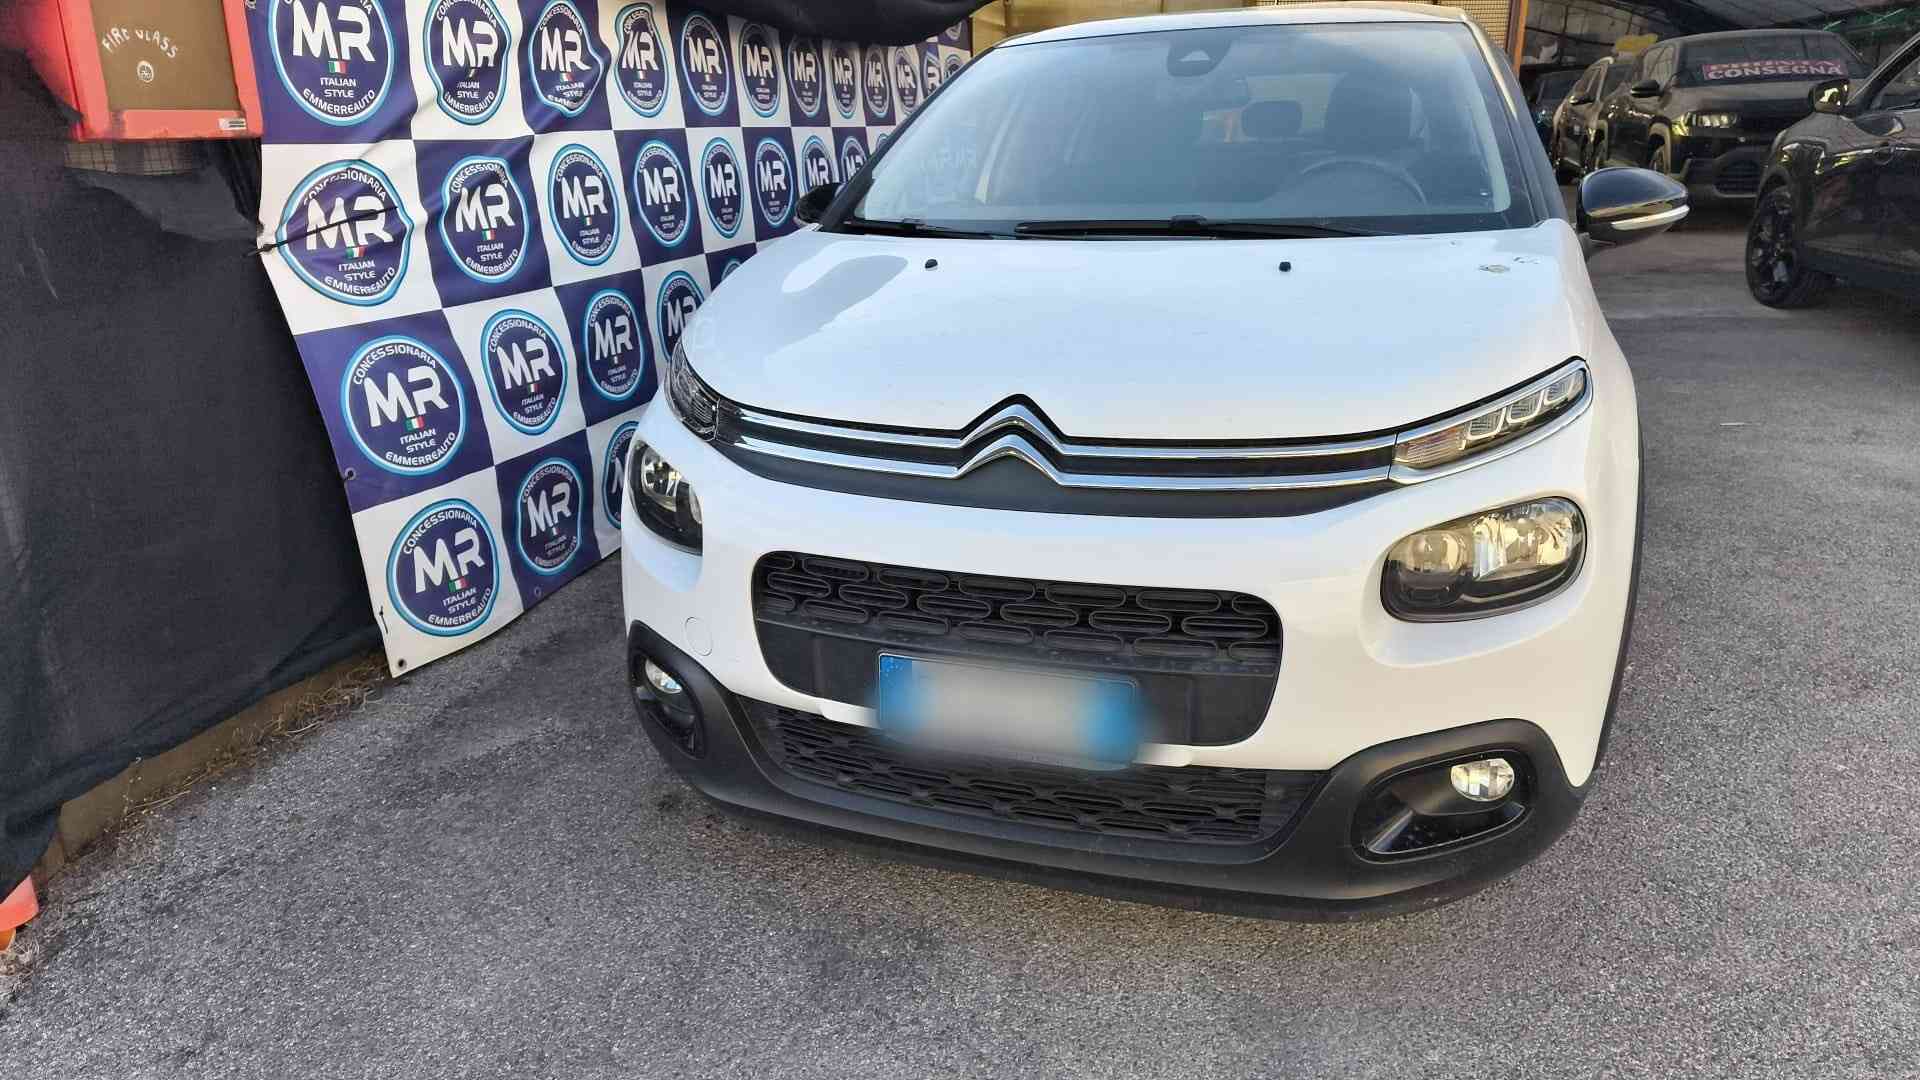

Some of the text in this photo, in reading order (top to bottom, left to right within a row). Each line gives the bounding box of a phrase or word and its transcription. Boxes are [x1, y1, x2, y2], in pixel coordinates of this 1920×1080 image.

[293, 1, 376, 62] MR
[442, 16, 499, 68] MR
[541, 27, 592, 73] MR
[622, 31, 659, 71] MR
[687, 37, 722, 74] MR
[746, 44, 775, 79] MR
[794, 49, 817, 82] MR
[320, 77, 357, 87] ITALIAN
[833, 55, 854, 87] MR
[867, 60, 884, 88] MR
[897, 63, 916, 89] MR
[1708, 65, 1843, 79] CONSEGNA
[303, 88, 375, 115] EMMERREAUTO
[324, 89, 354, 98] STYLE
[457, 91, 480, 99] STYLE
[642, 166, 681, 206] MR
[709, 160, 737, 199] MR
[759, 159, 786, 192] MR
[806, 157, 830, 187] MR
[455, 184, 516, 232] MR
[561, 175, 608, 219] MR
[306, 195, 394, 250] MR
[465, 248, 519, 273] EMMERREAUTO
[476, 243, 504, 253] ITALIAN
[480, 252, 503, 262] STYLE
[324, 267, 396, 295] EMMERREAUTO
[339, 260, 376, 272] ITALIAN
[344, 271, 376, 282] STYLE
[489, 319, 547, 353] CONCESSIONARIA
[595, 315, 633, 361] MR
[353, 344, 437, 385] CONCESSIONARIA
[497, 338, 556, 390] MR
[364, 365, 449, 428] MR
[525, 404, 543, 414] STYLE
[385, 432, 456, 466] EMMERREAUTO
[400, 428, 437, 445] ITALIAN
[406, 438, 436, 454] STYLE
[527, 481, 571, 537] MR
[403, 509, 478, 555] CONCESSIONARIA
[413, 527, 486, 593] MR
[428, 587, 491, 626] EMMERREAUTO
[442, 587, 478, 606] ITALIAN
[448, 598, 477, 614] STYLE
